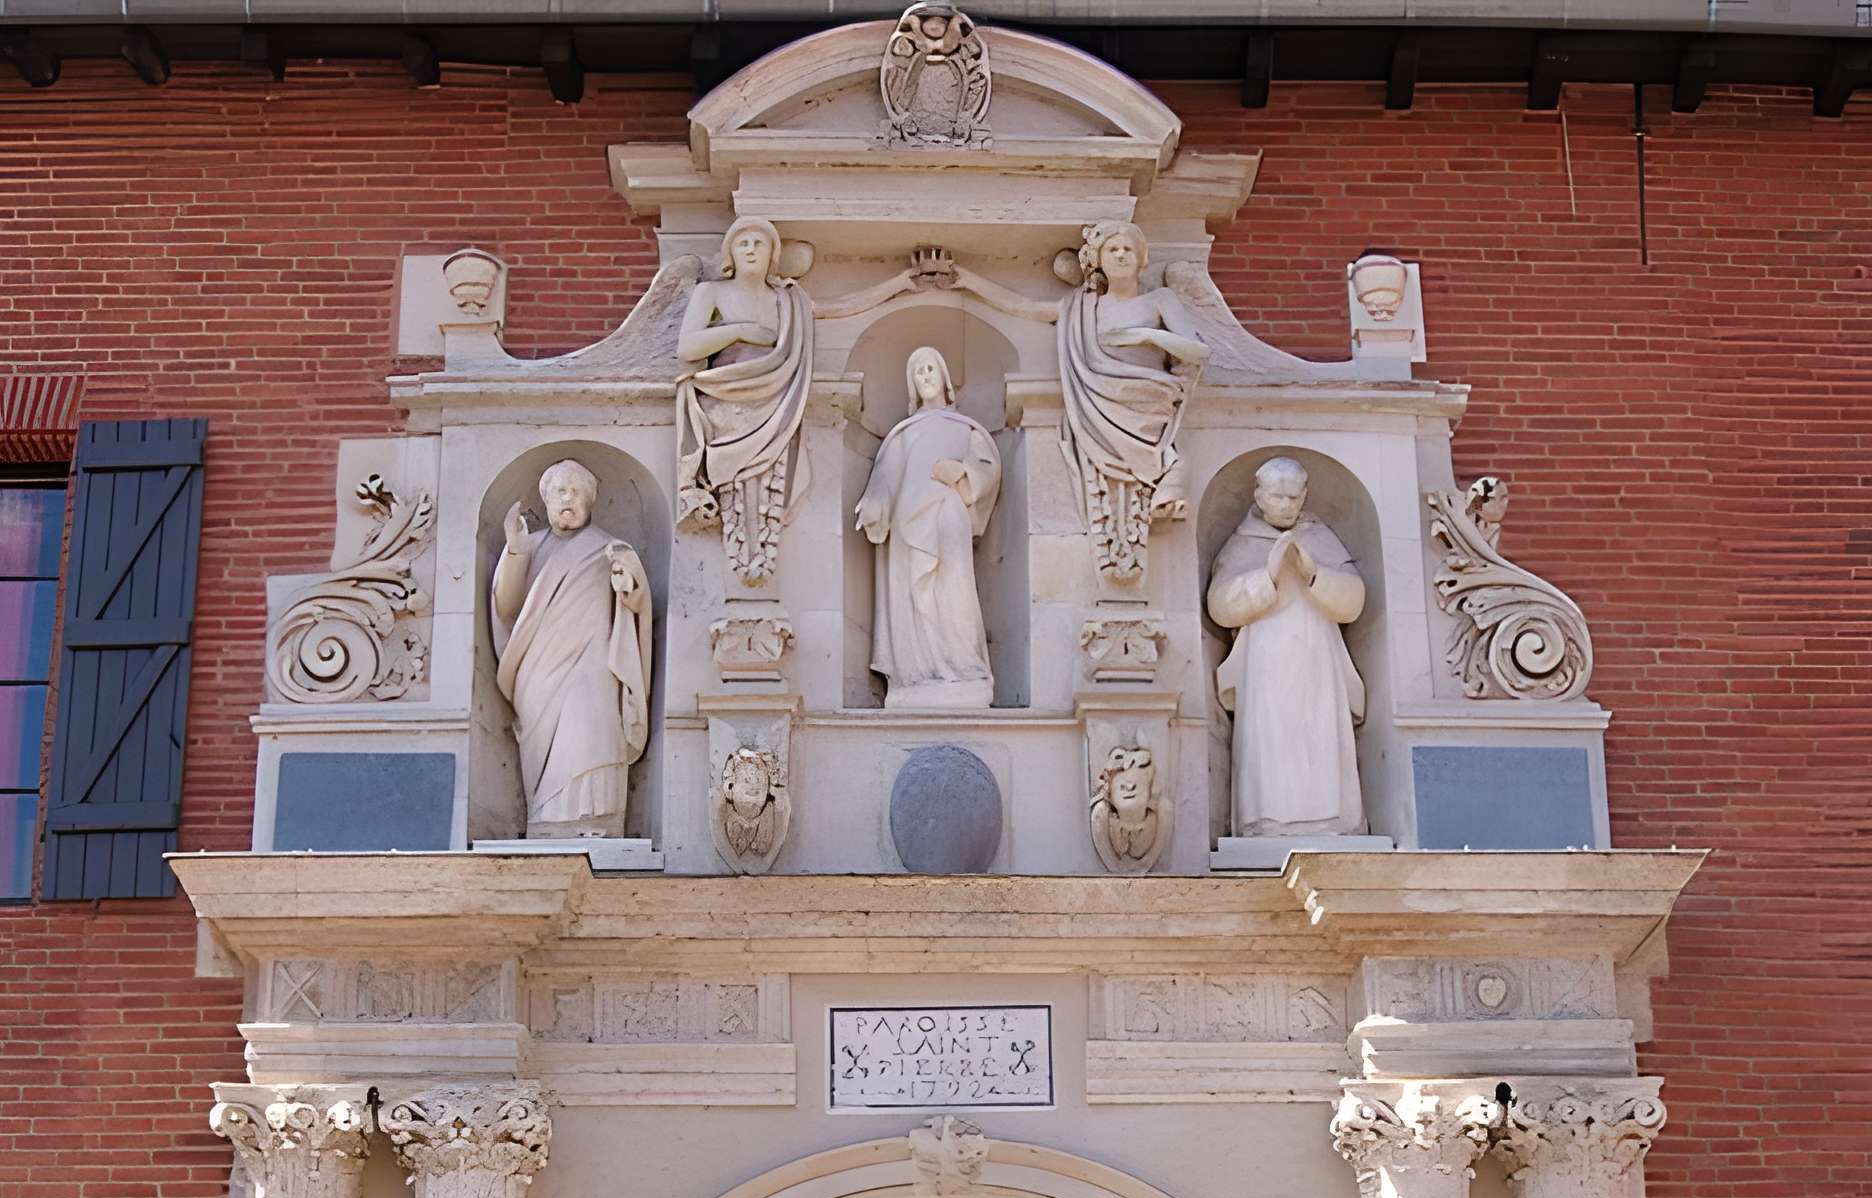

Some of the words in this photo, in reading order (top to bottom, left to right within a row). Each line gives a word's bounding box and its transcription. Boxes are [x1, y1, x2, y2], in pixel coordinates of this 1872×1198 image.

[855, 1015, 1015, 1035] PAROISSE
[892, 1034, 1000, 1056] SAINT
[877, 1058, 999, 1078] PIERRE
[910, 1080, 985, 1099] 1792
